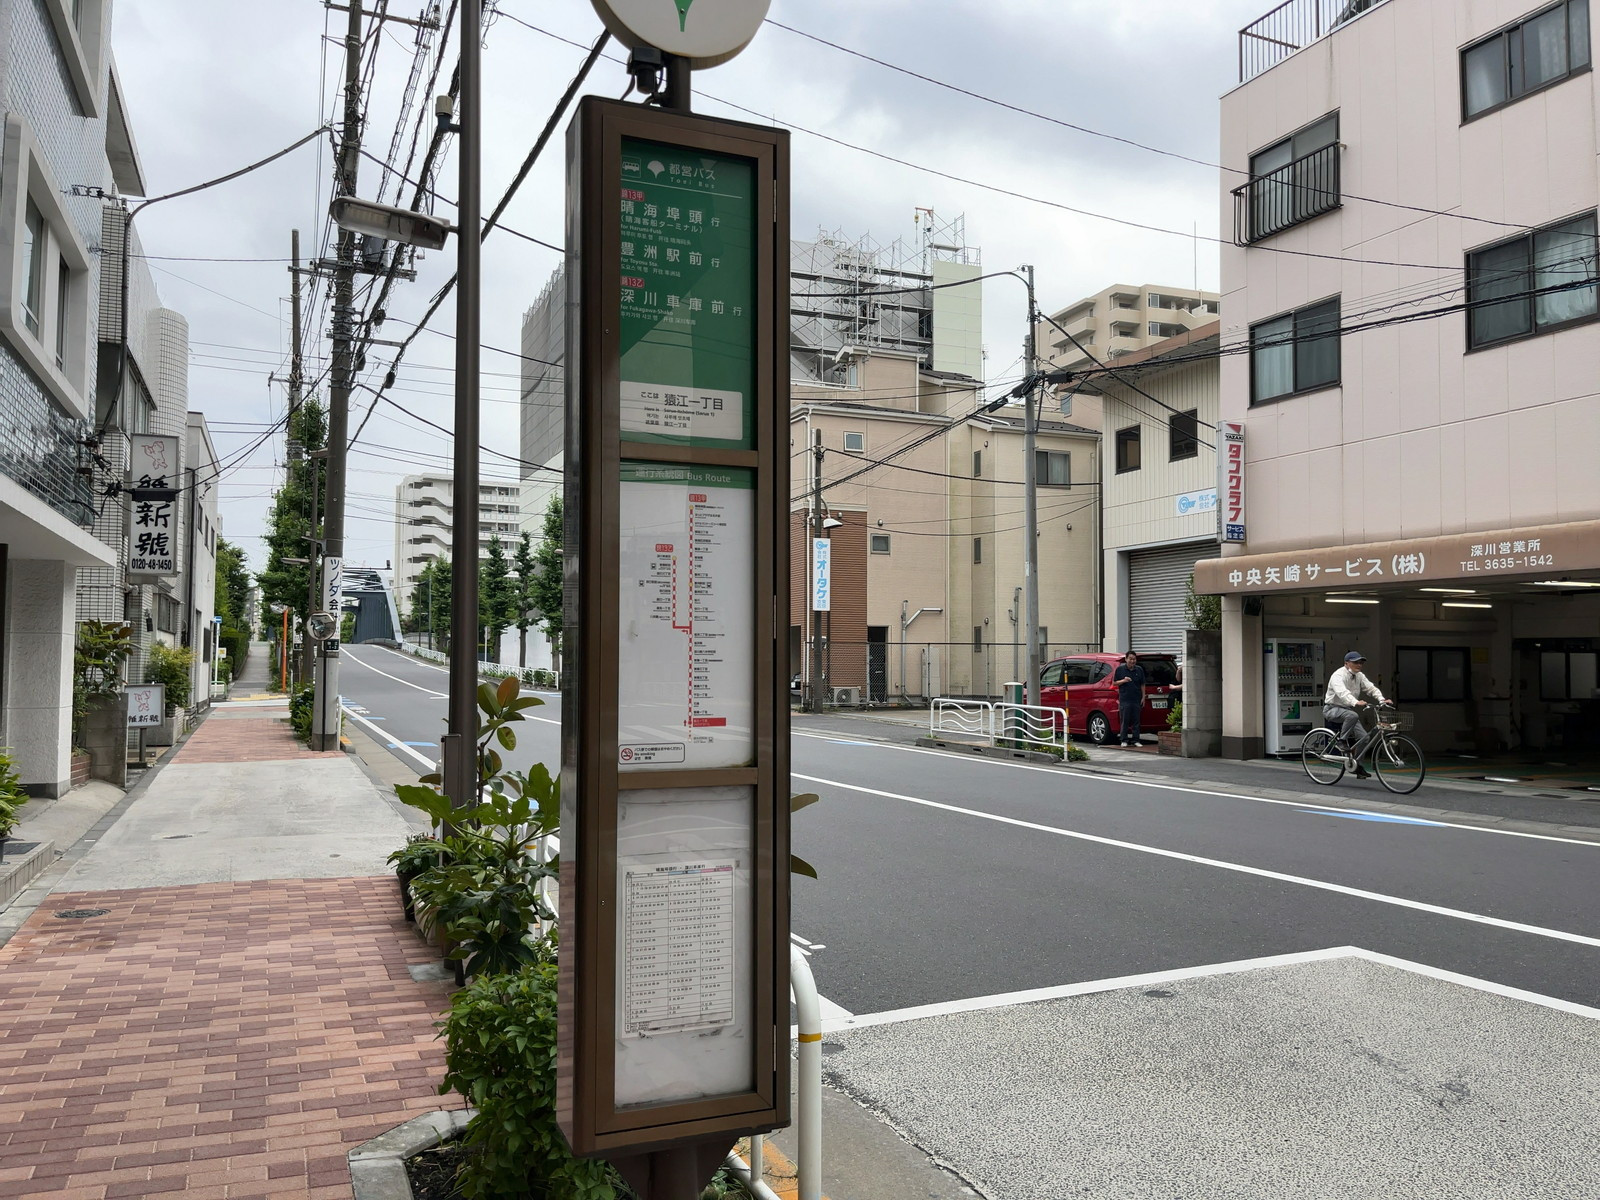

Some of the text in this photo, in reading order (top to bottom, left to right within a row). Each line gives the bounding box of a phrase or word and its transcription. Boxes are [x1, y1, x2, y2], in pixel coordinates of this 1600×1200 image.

[669, 163, 716, 181] 都営バス
[670, 177, 692, 186] Toei
[664, 393, 723, 411] 猿江一丁目
[687, 472, 703, 481] Bus
[705, 473, 731, 483] Route
[1227, 525, 1245, 533] サービス
[1470, 538, 1541, 557] 深川営業所
[131, 558, 172, 571] 0120-48-1450
[1460, 554, 1553, 572] TEL 3635-1542
[816, 560, 827, 599] オータケ
